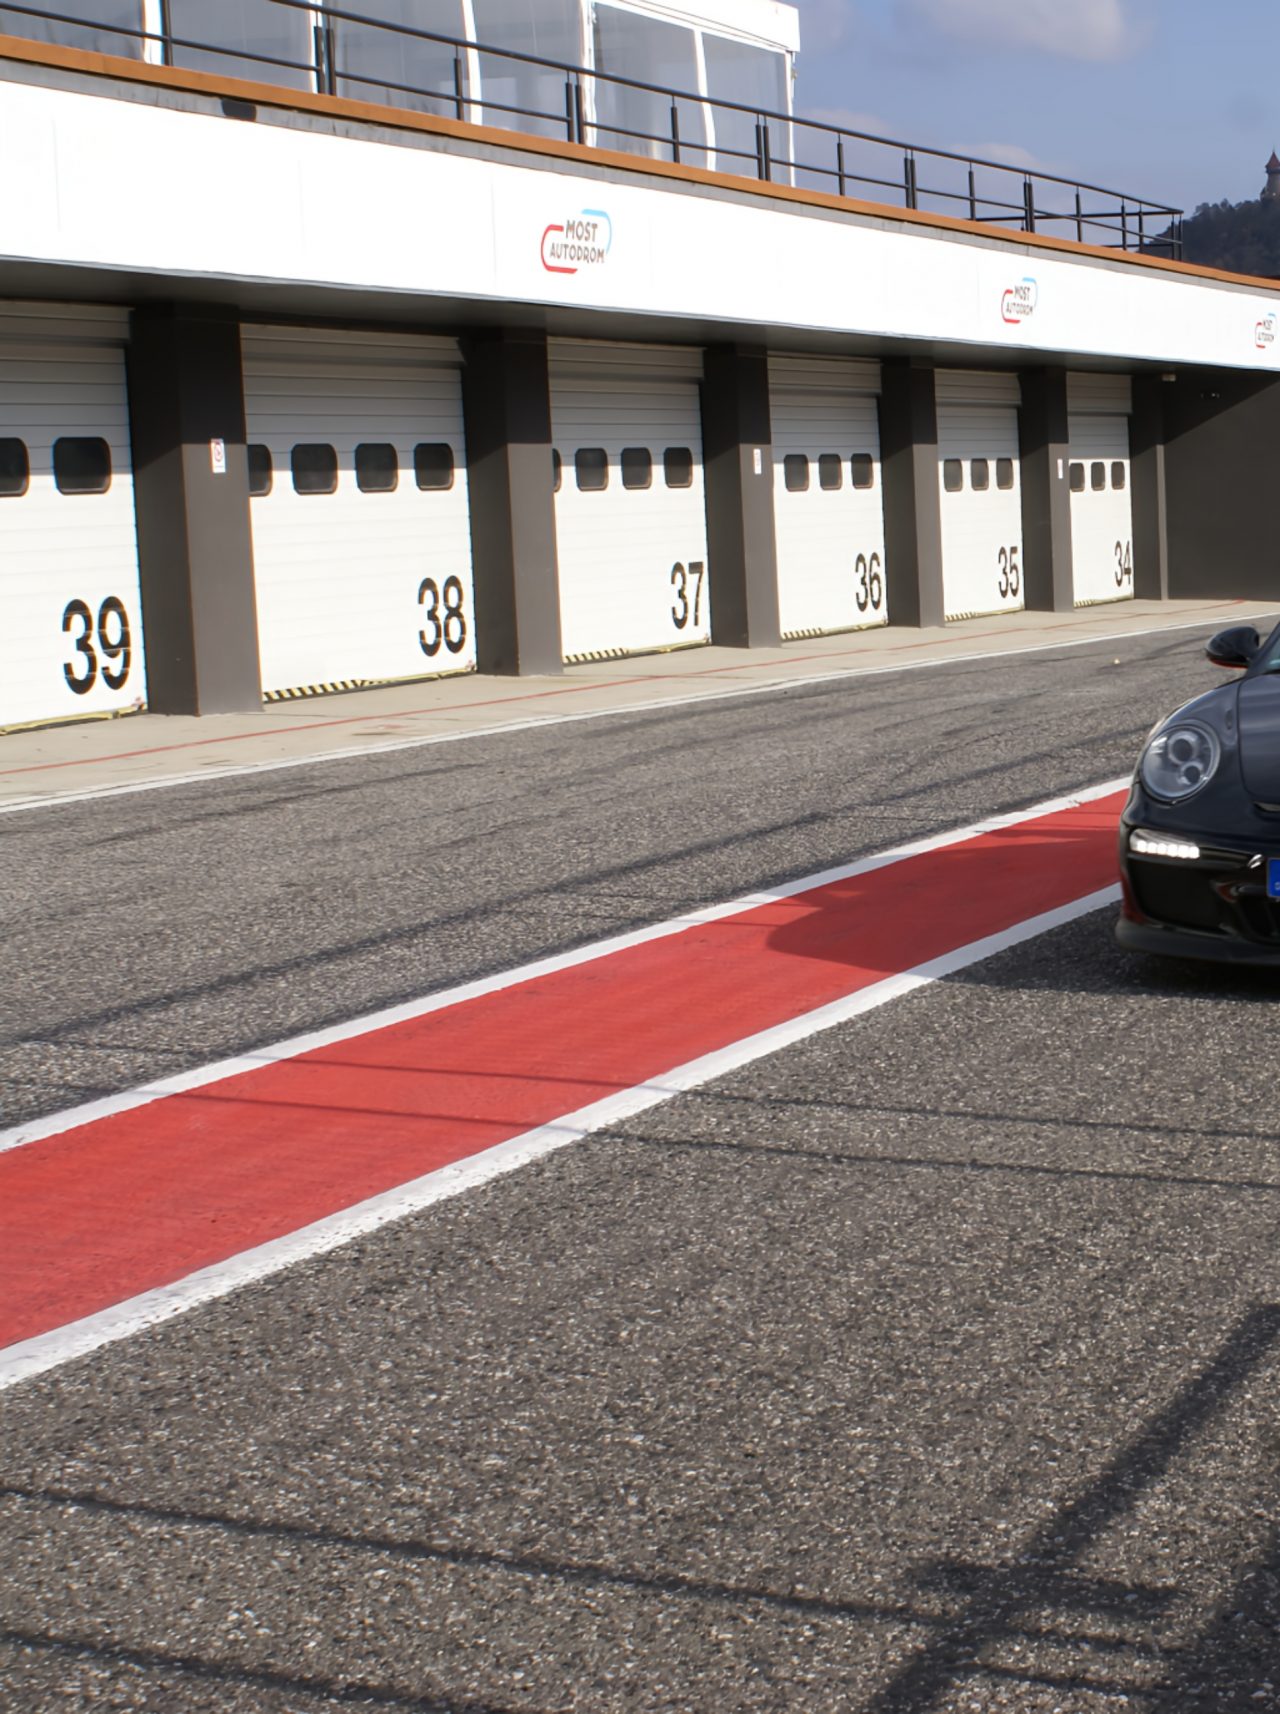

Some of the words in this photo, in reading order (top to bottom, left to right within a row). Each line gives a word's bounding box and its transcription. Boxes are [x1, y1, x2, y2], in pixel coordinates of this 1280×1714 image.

[549, 242, 605, 264] AUTODROM
[565, 219, 598, 242] MOST
[855, 552, 882, 612] 36
[998, 546, 1019, 598] 35
[1115, 541, 1132, 587] 34
[418, 575, 466, 657] 38
[671, 561, 703, 630] 37
[62, 596, 131, 695] 39
